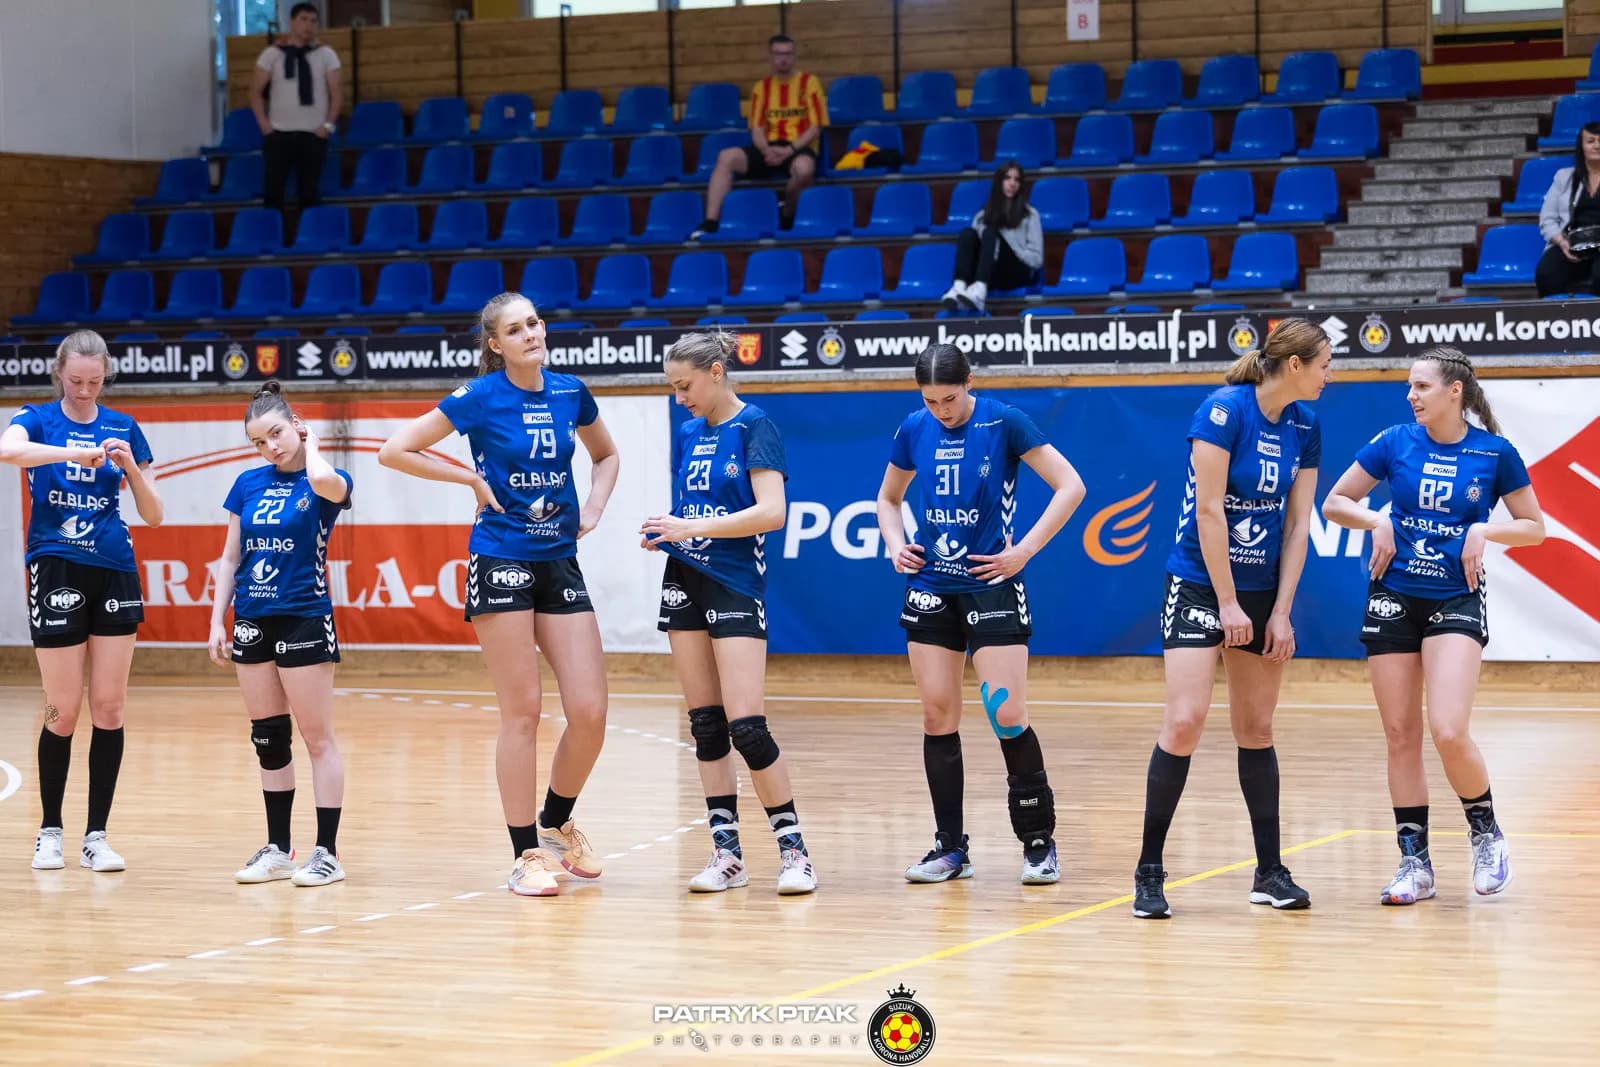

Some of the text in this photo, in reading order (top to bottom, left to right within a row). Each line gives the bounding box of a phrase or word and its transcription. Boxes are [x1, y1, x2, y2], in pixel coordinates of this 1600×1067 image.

[854, 319, 1216, 358] wwwkoronahandball.pl
[526, 429, 557, 459] 79
[686, 460, 712, 490] 23
[936, 464, 960, 495] 31
[1257, 459, 1279, 493] 19
[252, 498, 285, 524] 22
[1419, 478, 1453, 513] 82
